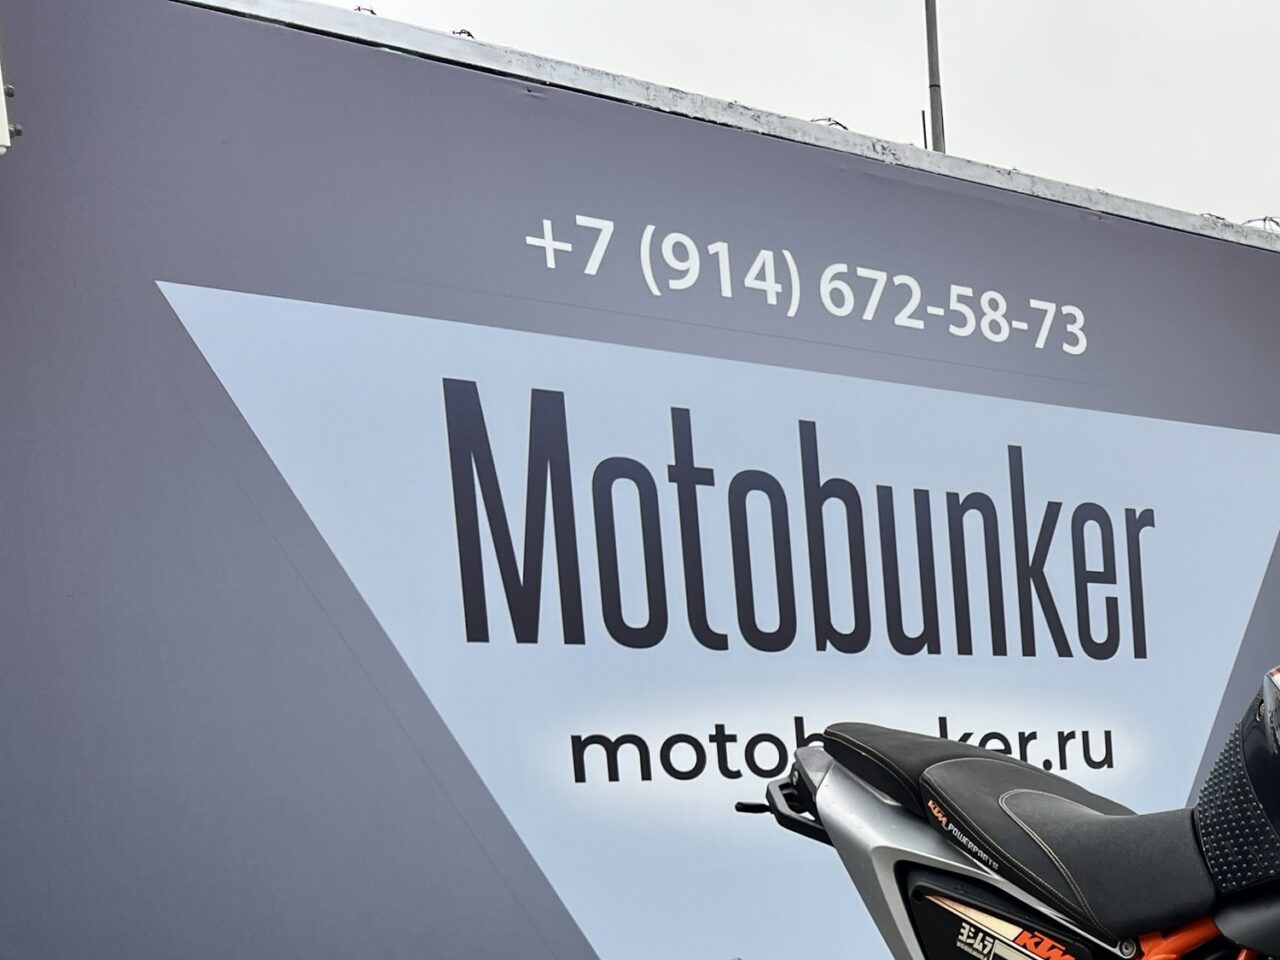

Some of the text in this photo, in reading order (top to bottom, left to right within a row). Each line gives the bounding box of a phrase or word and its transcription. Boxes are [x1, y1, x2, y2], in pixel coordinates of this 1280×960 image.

[525, 214, 1088, 355] +7 (914) 672-58-73
[442, 377, 1156, 660] Motobunker
[570, 716, 1114, 784] motoer.ru
[958, 921, 994, 955] ヨシムラ
